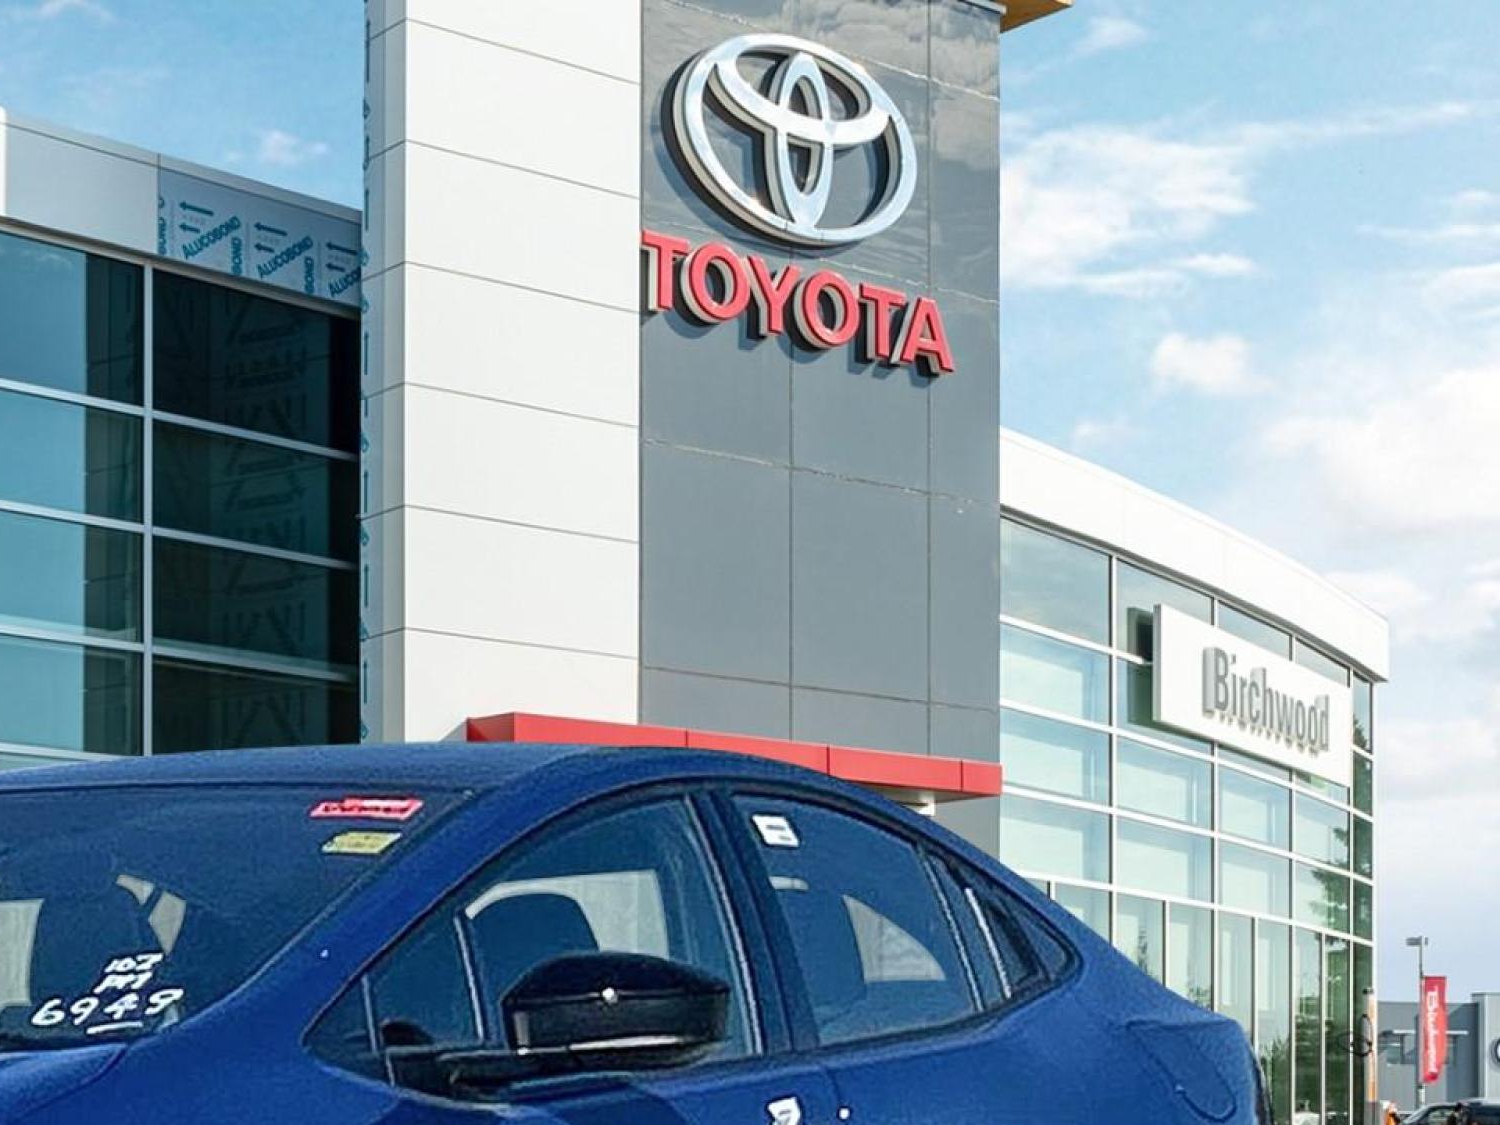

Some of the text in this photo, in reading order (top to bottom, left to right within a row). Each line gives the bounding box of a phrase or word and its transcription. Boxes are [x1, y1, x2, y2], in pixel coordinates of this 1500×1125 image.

[181, 216, 241, 260] ALUCOBOND
[257, 236, 314, 279] ALUCOBOND
[641, 229, 955, 373] TOYOTA
[1205, 646, 1330, 754] Birchwood
